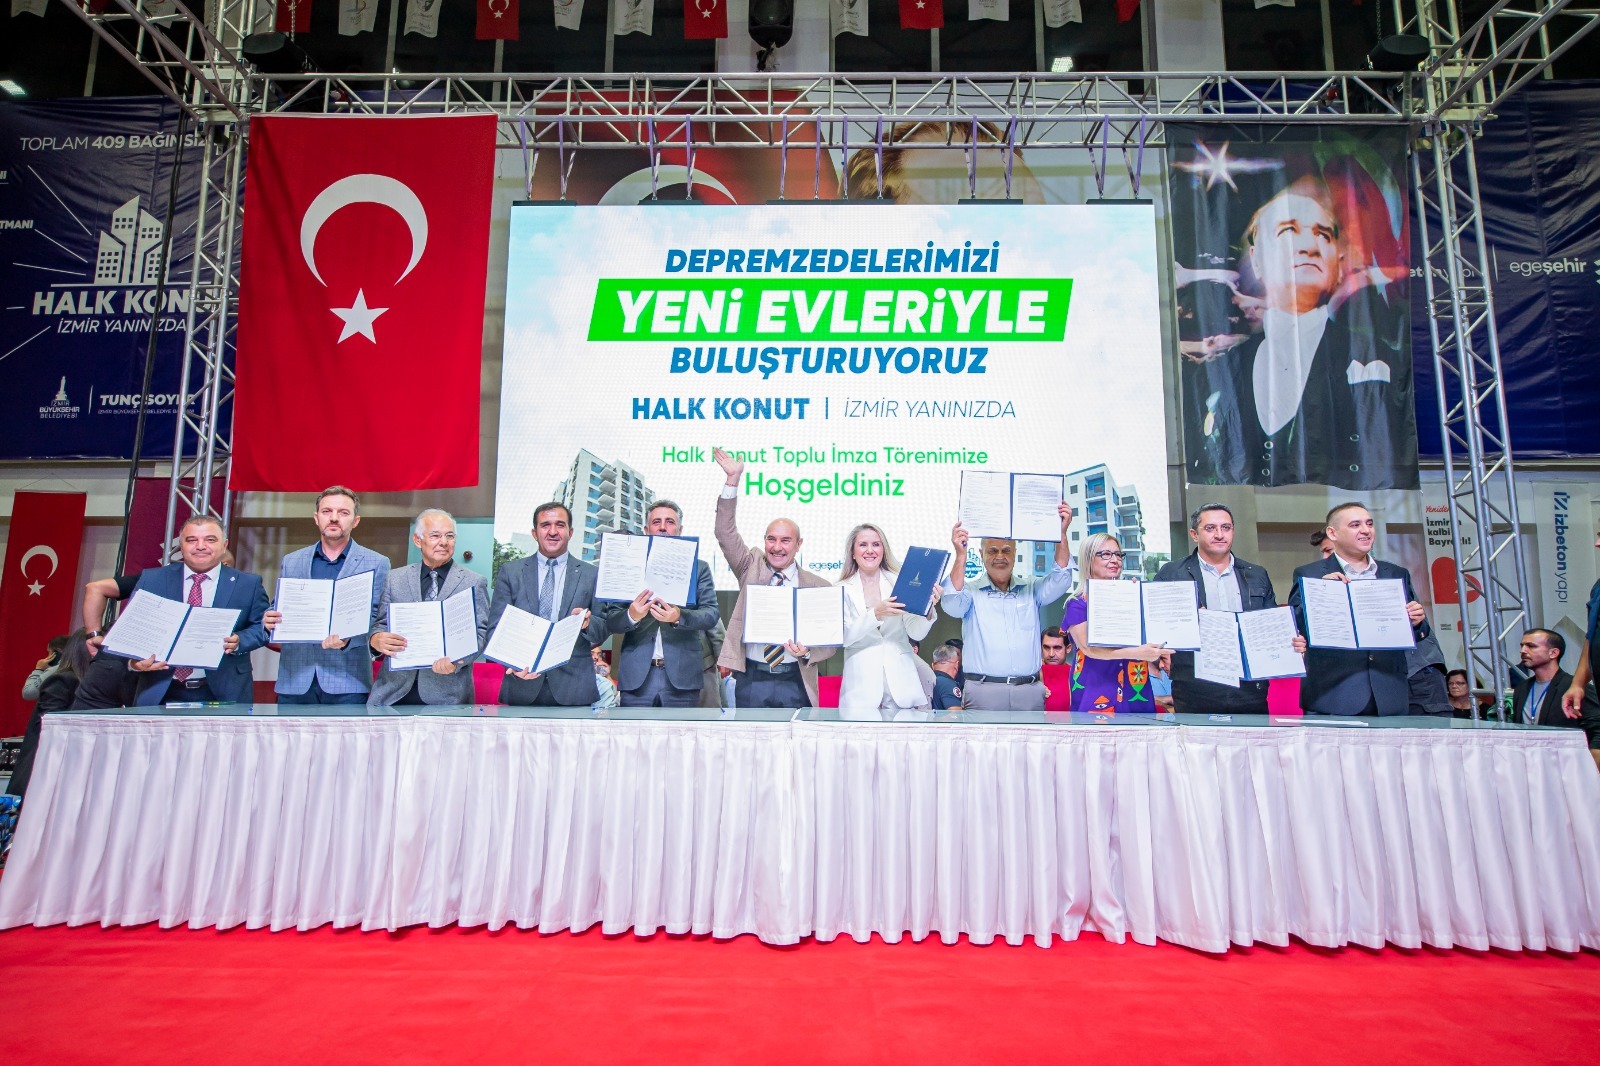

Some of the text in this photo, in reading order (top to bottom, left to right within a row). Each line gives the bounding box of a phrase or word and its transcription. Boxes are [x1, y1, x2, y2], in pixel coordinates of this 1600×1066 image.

[20, 136, 89, 151] TOPLAM
[91, 135, 126, 149] 409
[665, 240, 1000, 273] DEPREMZEDELERİMİZİ
[1509, 257, 1587, 277] egeşehir
[32, 290, 115, 315] HALK
[57, 317, 187, 333] İZMİR YANINZDA
[670, 346, 989, 381] BULUŞTURUYORUZ
[100, 394, 141, 409] TUNÇ
[632, 397, 810, 420] HALK KONUT
[844, 396, 1016, 419] İZMİR YANINIZDA
[662, 444, 705, 464] Halk
[773, 444, 826, 468] Toplu
[831, 442, 877, 464] İmza
[883, 445, 988, 464] Törenimize
[745, 471, 904, 504] Hoşgeldiniz
[1425, 504, 1450, 513] Yenide
[1427, 528, 1451, 536] kalbi
